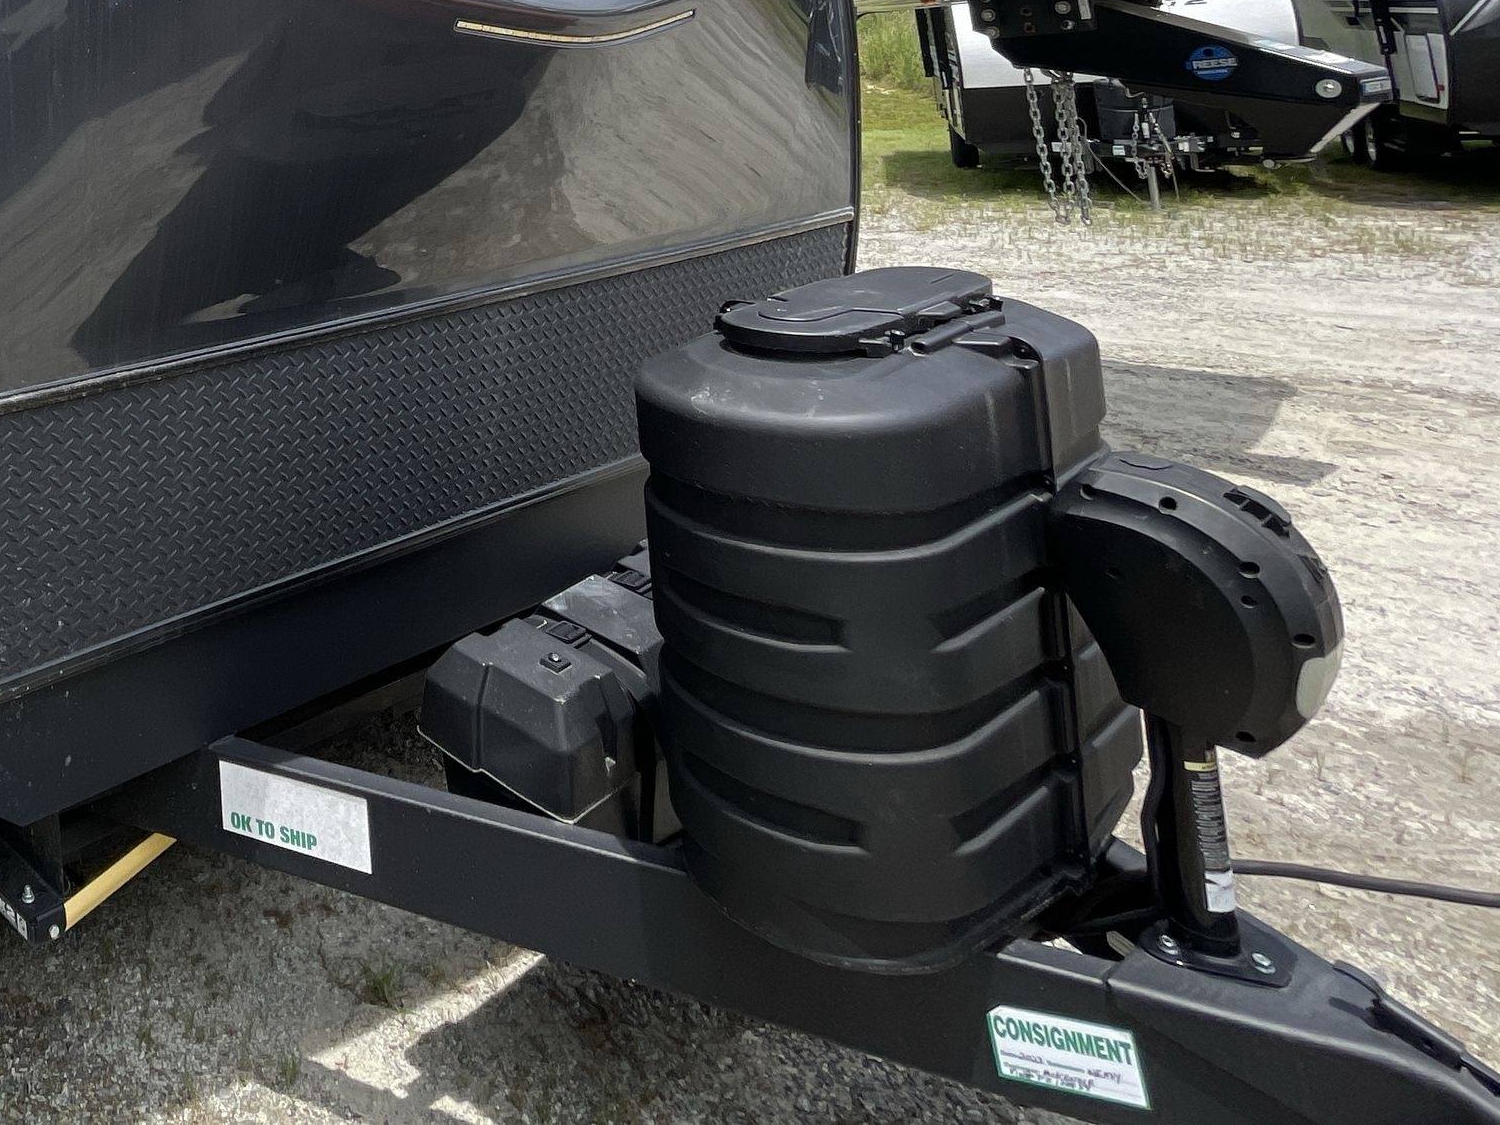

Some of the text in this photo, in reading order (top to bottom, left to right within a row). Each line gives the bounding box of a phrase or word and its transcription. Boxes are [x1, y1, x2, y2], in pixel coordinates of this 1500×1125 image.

[1192, 57, 1238, 70] REESE
[231, 811, 318, 851] OK TO SHIP
[992, 1014, 1133, 1067] CONSIGNMENT
